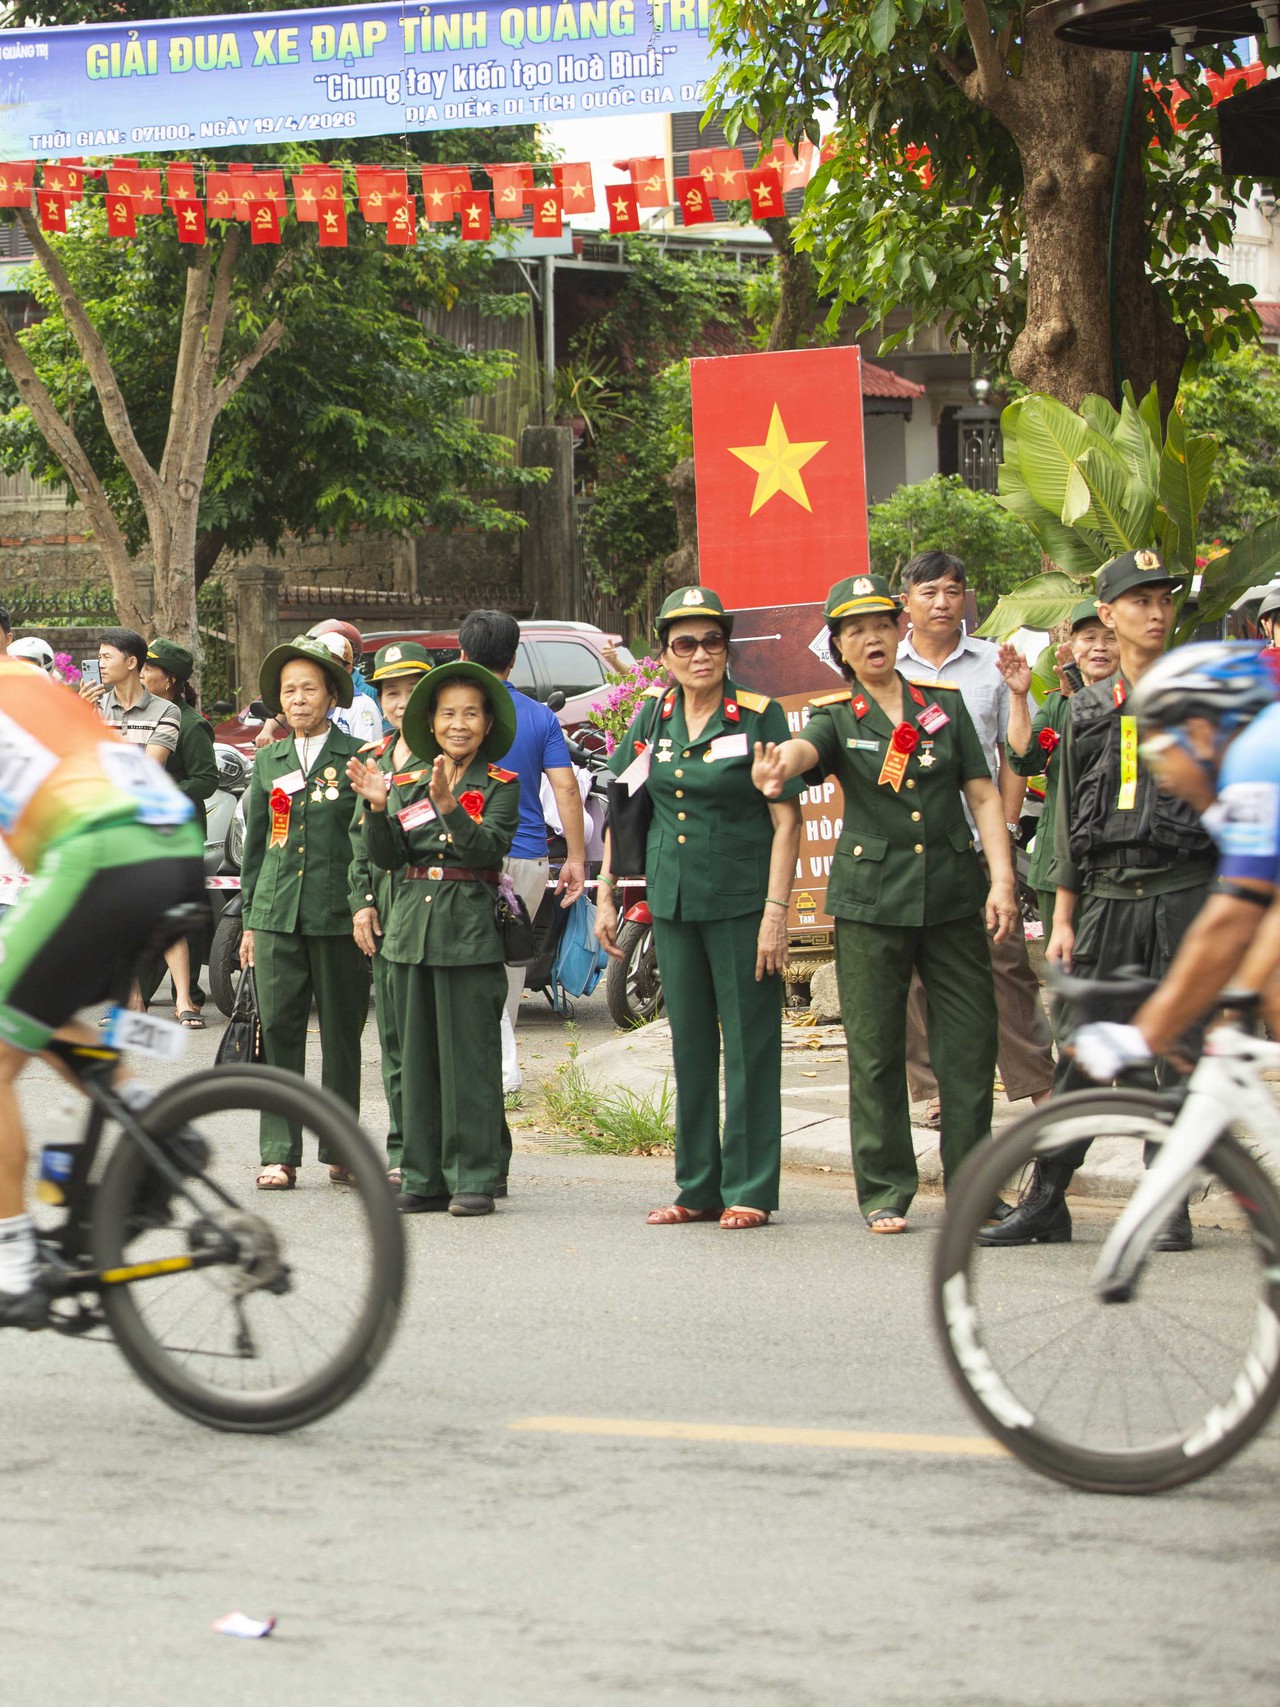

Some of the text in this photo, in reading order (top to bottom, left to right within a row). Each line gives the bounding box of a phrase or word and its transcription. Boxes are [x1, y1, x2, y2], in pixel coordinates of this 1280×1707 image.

[2, 41, 35, 60] QUẢNG
[35, 43, 48, 60] TRỊ
[86, 0, 709, 80] GIẢI ĐUA XE ĐẠP TỈNH QUẢNG TRỊ
[407, 67, 447, 100] tay
[453, 59, 505, 92] kiến
[512, 59, 551, 91] tạo
[558, 50, 604, 84] Hoà
[405, 105, 438, 125] ĐỊA
[444, 95, 498, 118] ĐIỂM:
[504, 98, 524, 114] DI
[529, 92, 575, 113] TÍCH
[581, 84, 635, 110] QUỐC
[640, 86, 674, 104] GIA
[29, 111, 357, 150] THỜI GIAN: 07H00, NGÀY 19/4/2026
[821, 652, 834, 660] AC
